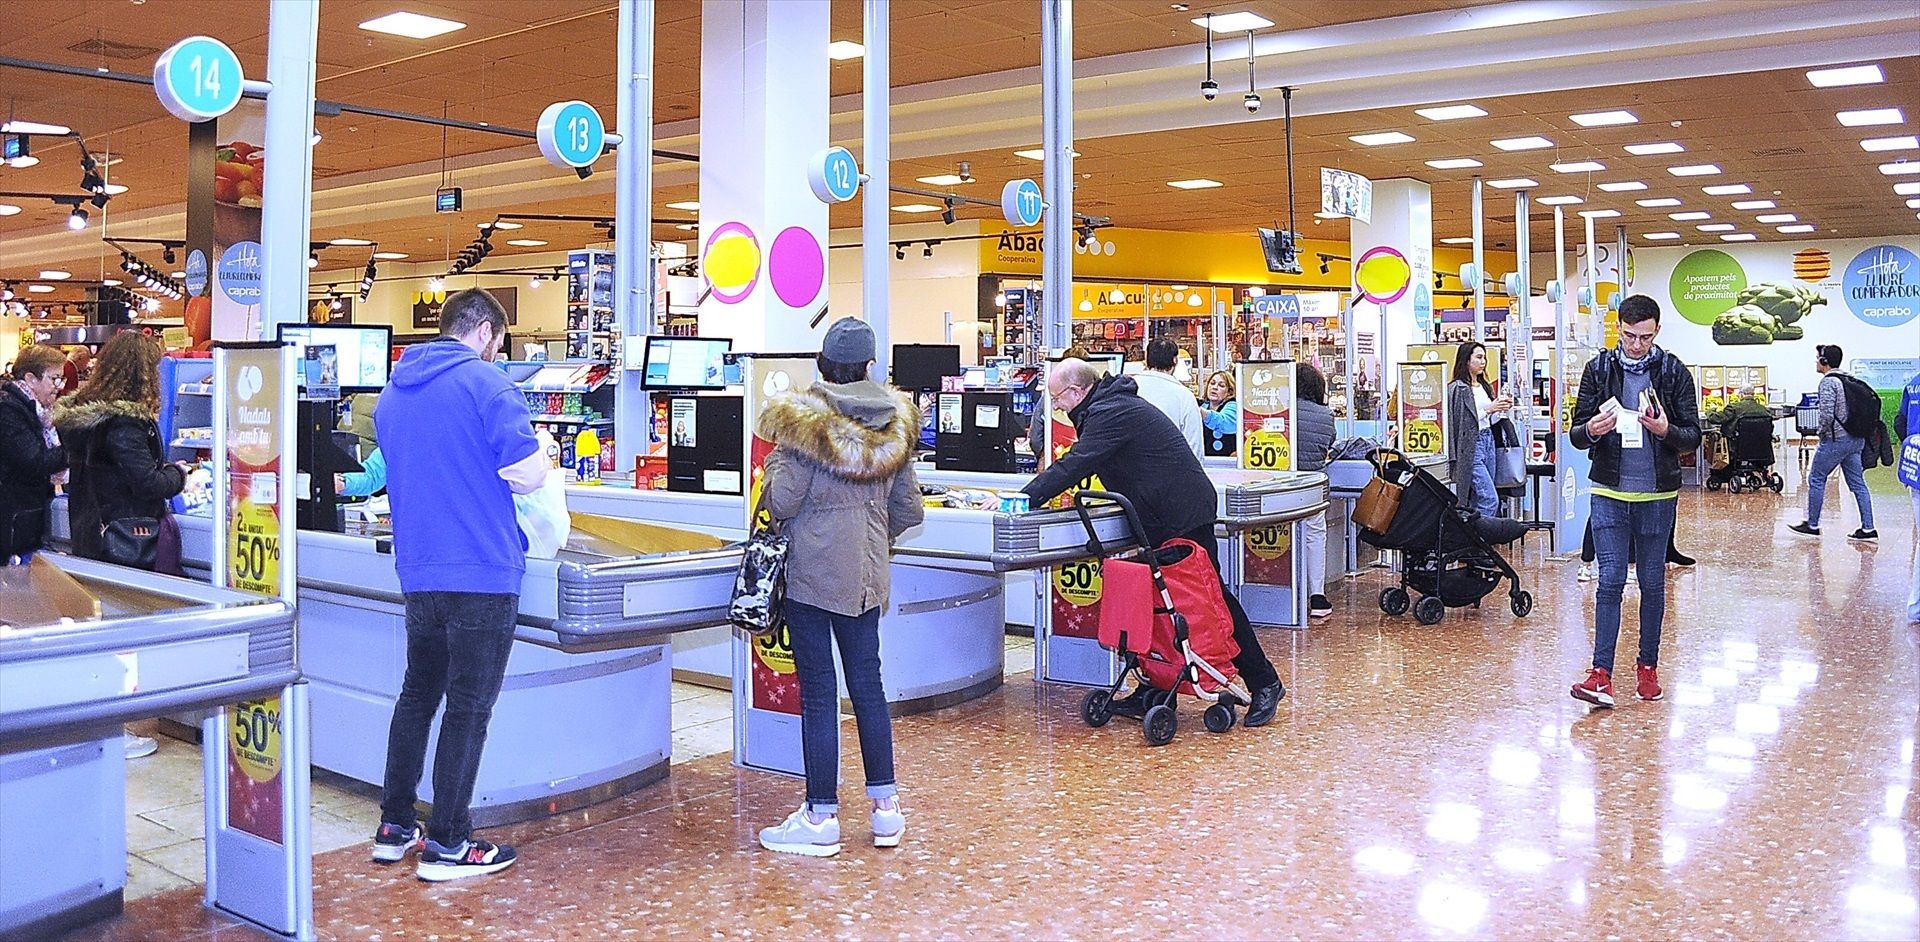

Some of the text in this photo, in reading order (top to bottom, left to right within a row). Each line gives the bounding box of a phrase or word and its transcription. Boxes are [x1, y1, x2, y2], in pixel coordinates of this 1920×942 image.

[189, 54, 221, 100] 14
[568, 116, 589, 152] 13
[833, 159, 850, 188] 12
[1023, 189, 1035, 215] 11
[998, 254, 1036, 264] Cooperativa
[1857, 247, 1912, 284] Hola
[1684, 273, 1737, 285] Apostem pels
[1866, 273, 1905, 287] LLIURE
[228, 287, 260, 297] caprab
[1690, 283, 1730, 293] productes
[1852, 285, 1920, 300] COMPRADOR
[1684, 291, 1738, 301] de proximitat
[1256, 300, 1298, 314] CAIXA
[1863, 306, 1911, 318] caprabo
[1251, 387, 1280, 397] Nadals
[1251, 397, 1269, 406] amb
[238, 406, 271, 425] Nadals
[1408, 432, 1440, 449] 50%
[1250, 446, 1288, 468] 50%
[236, 533, 280, 581] 50%
[1060, 562, 1103, 589] 50%
[467, 847, 485, 862] N
